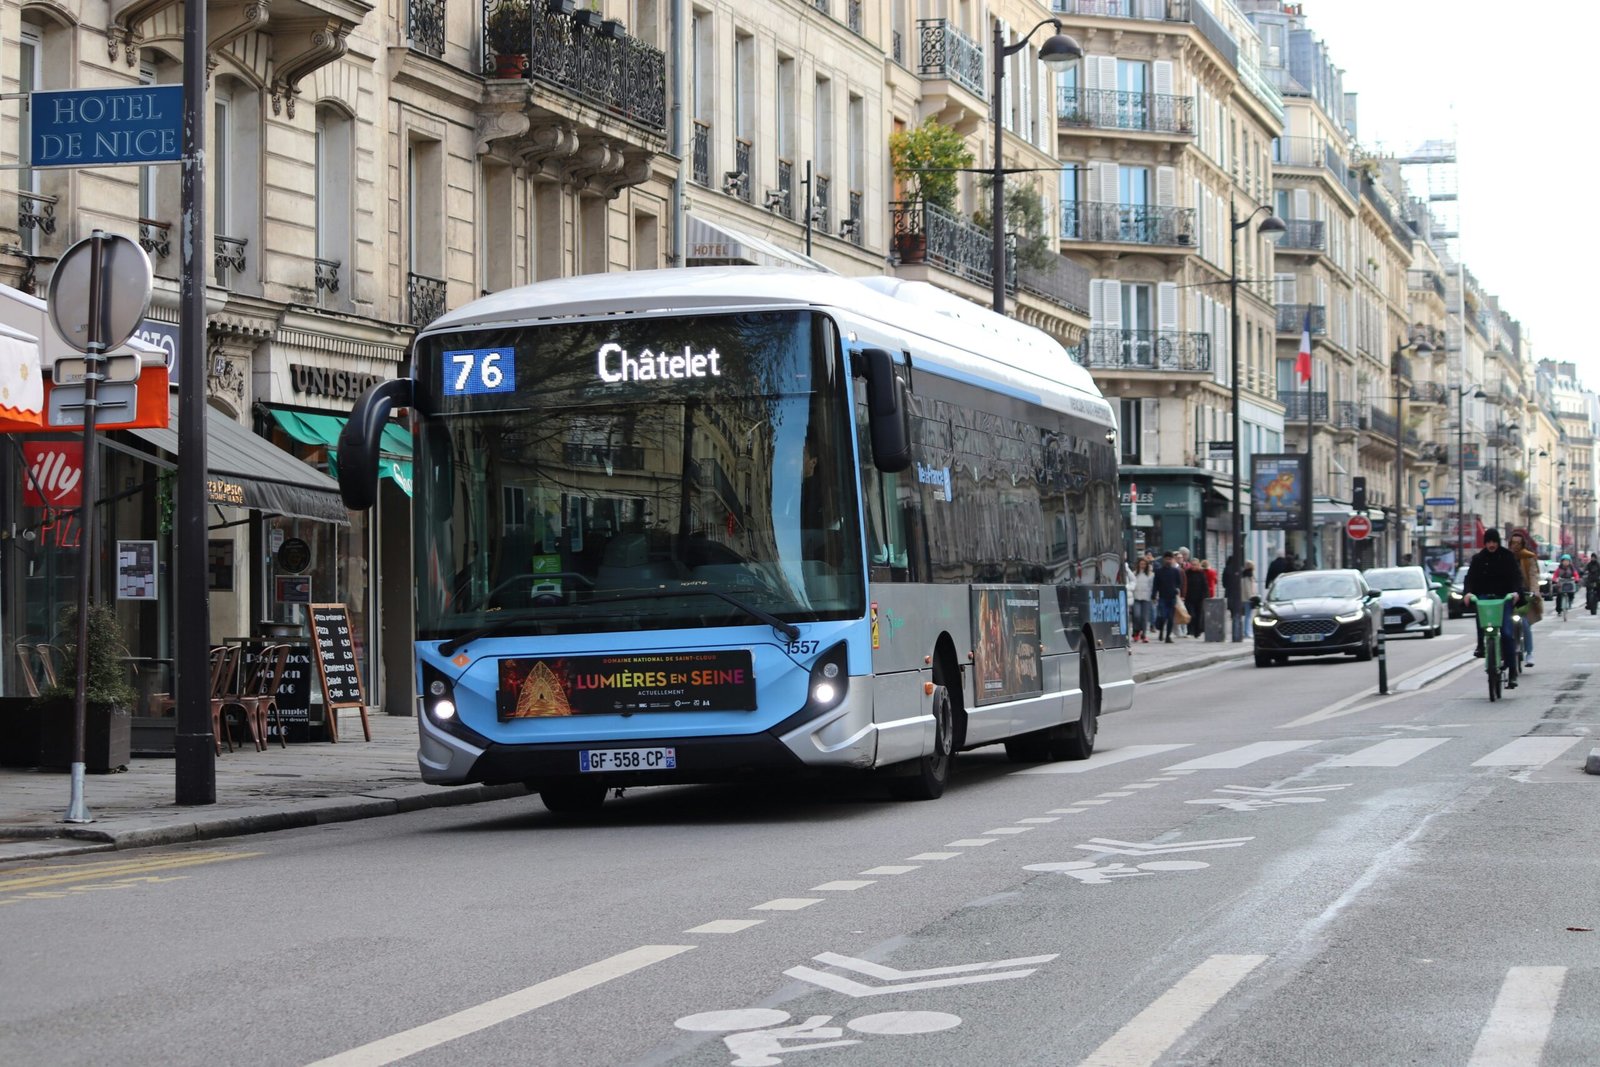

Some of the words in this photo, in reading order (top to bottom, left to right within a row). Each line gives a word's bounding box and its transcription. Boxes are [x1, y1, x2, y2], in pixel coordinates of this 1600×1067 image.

[52, 94, 162, 124] HOTEL
[40, 132, 83, 160] DE
[92, 128, 177, 157] NICE
[693, 245, 728, 256] HOTEL
[452, 353, 503, 391] 76
[598, 342, 721, 383] Châtelet
[290, 364, 385, 400] UNISHO
[27, 451, 81, 500] illy
[285, 653, 310, 664] box
[785, 641, 820, 655] 1557
[576, 669, 668, 689] LUMIÈRES
[670, 673, 687, 684] EN
[690, 669, 744, 685] SEINE
[590, 750, 664, 769] GF-558-CP
